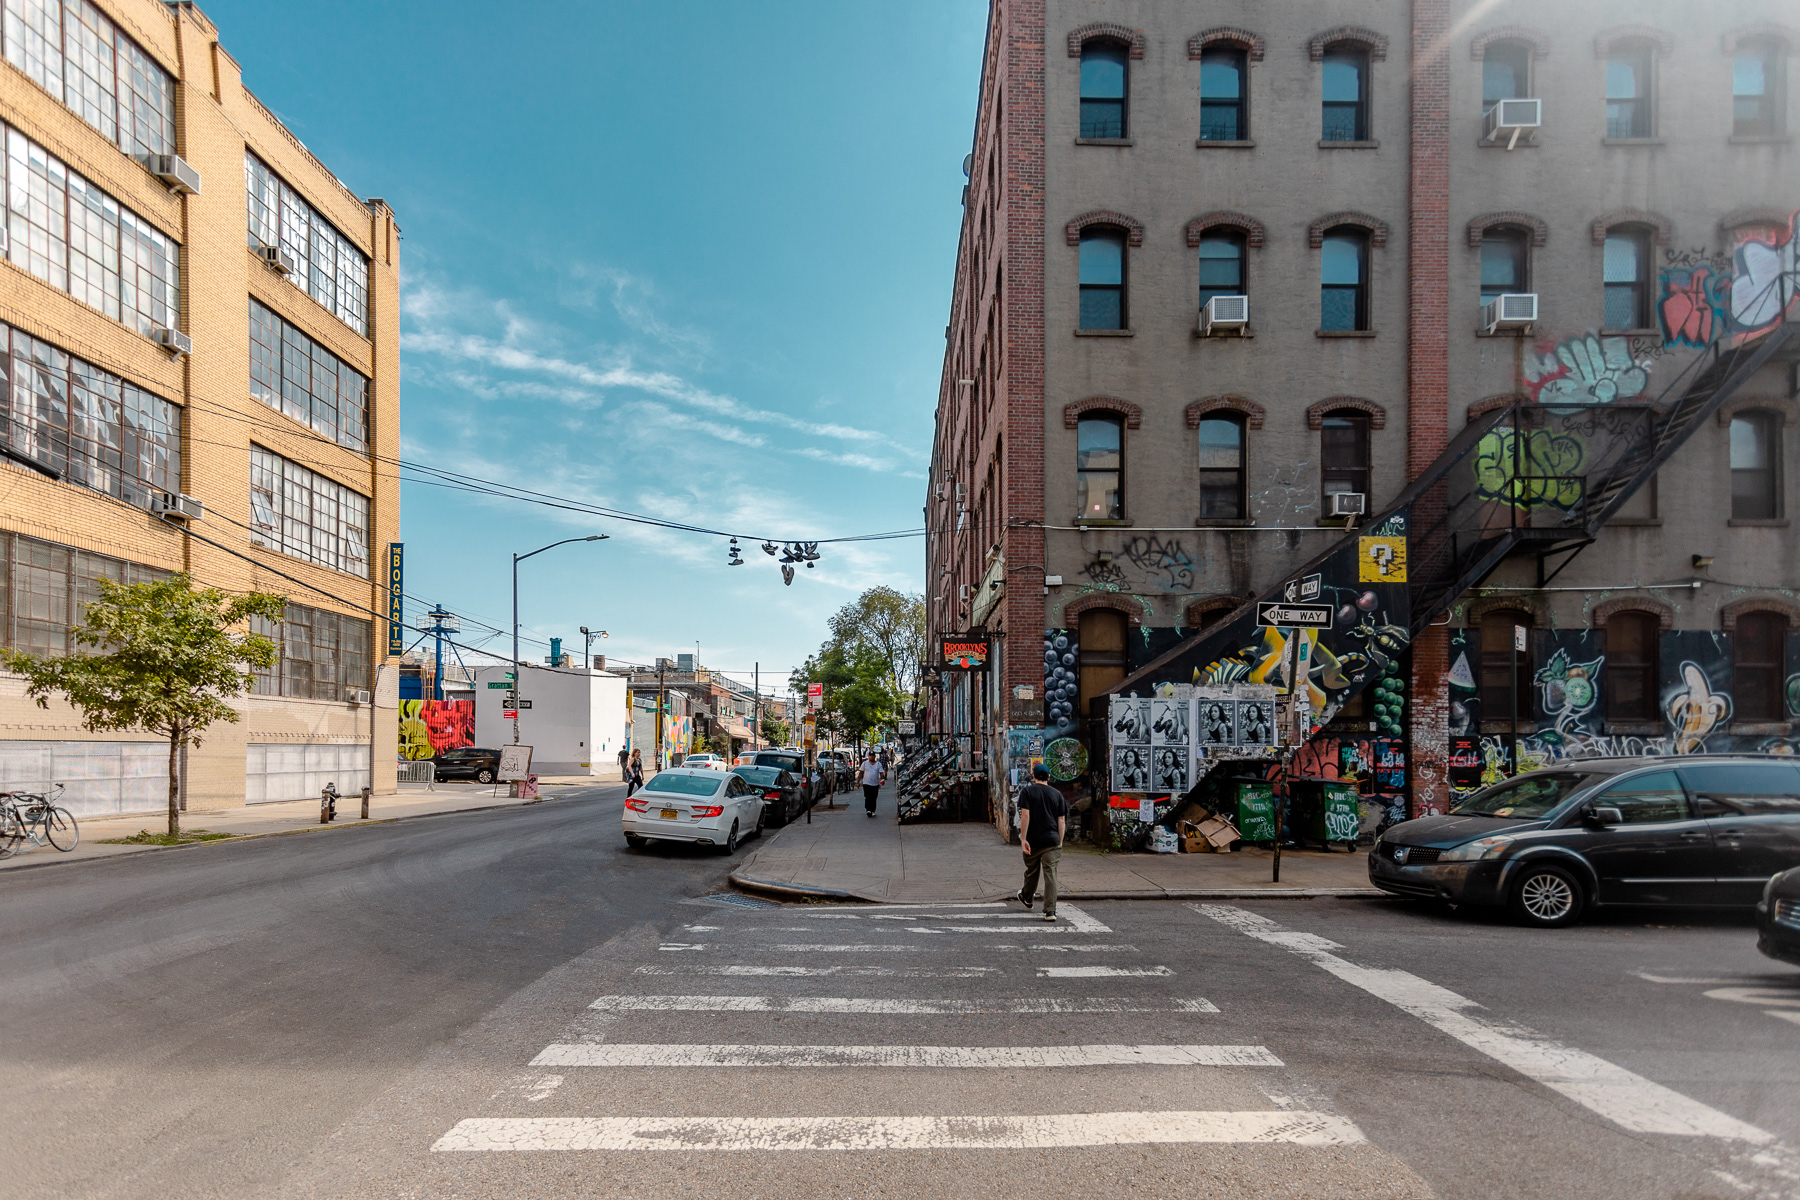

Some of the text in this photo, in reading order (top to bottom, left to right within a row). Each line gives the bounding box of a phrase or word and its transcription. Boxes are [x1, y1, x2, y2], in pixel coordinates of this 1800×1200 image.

[393, 547, 402, 555] THE
[1303, 581, 1317, 592] WAY
[392, 554, 401, 639] BOGART
[1269, 610, 1322, 621] ONE WAY
[1334, 792, 1347, 800] BIC
